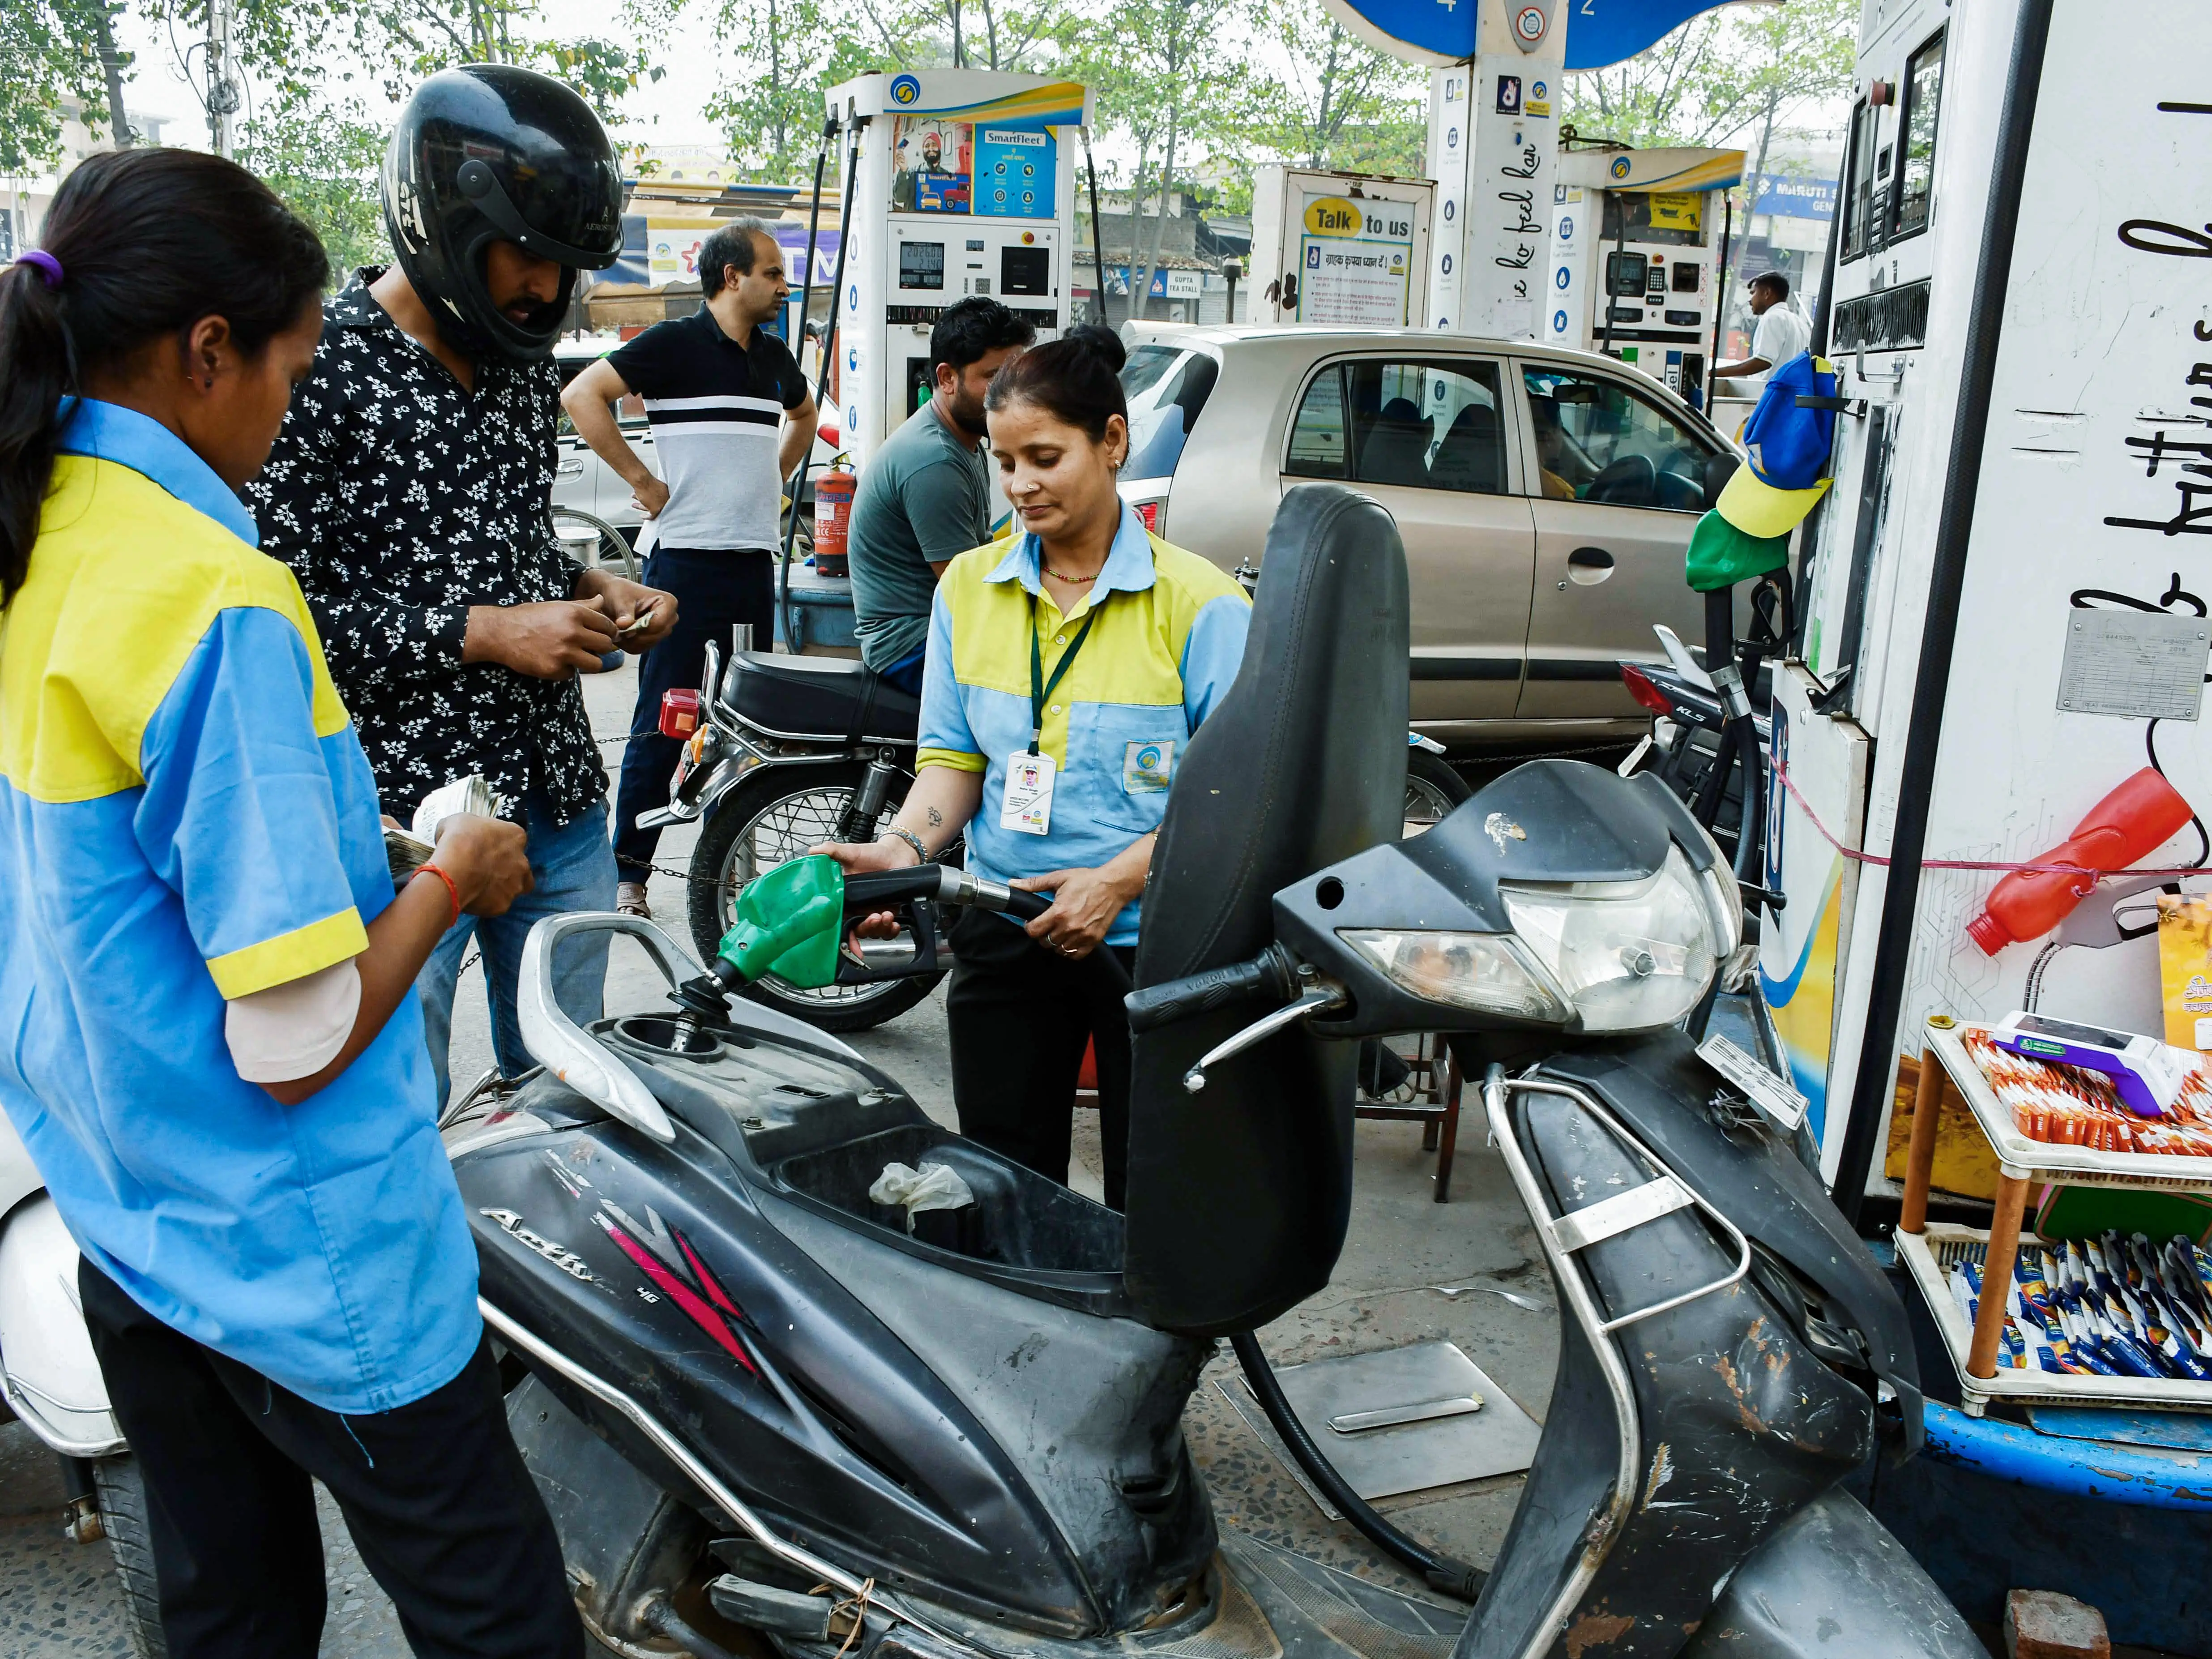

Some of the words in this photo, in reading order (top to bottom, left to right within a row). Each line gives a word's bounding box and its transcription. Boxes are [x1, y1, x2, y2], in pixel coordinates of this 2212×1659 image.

[988, 133, 1040, 144] SmartFleet
[1501, 143, 1541, 179] kar
[1776, 183, 1827, 198] MARUTI
[1498, 190, 1542, 233] feel
[1317, 209, 1351, 231] Talk
[1366, 214, 1382, 234] to
[1389, 221, 1409, 236] us
[1326, 254, 1344, 266] ग्राहक
[1174, 276, 1194, 284] GUPTA
[636, 1286, 661, 1304] 4G
